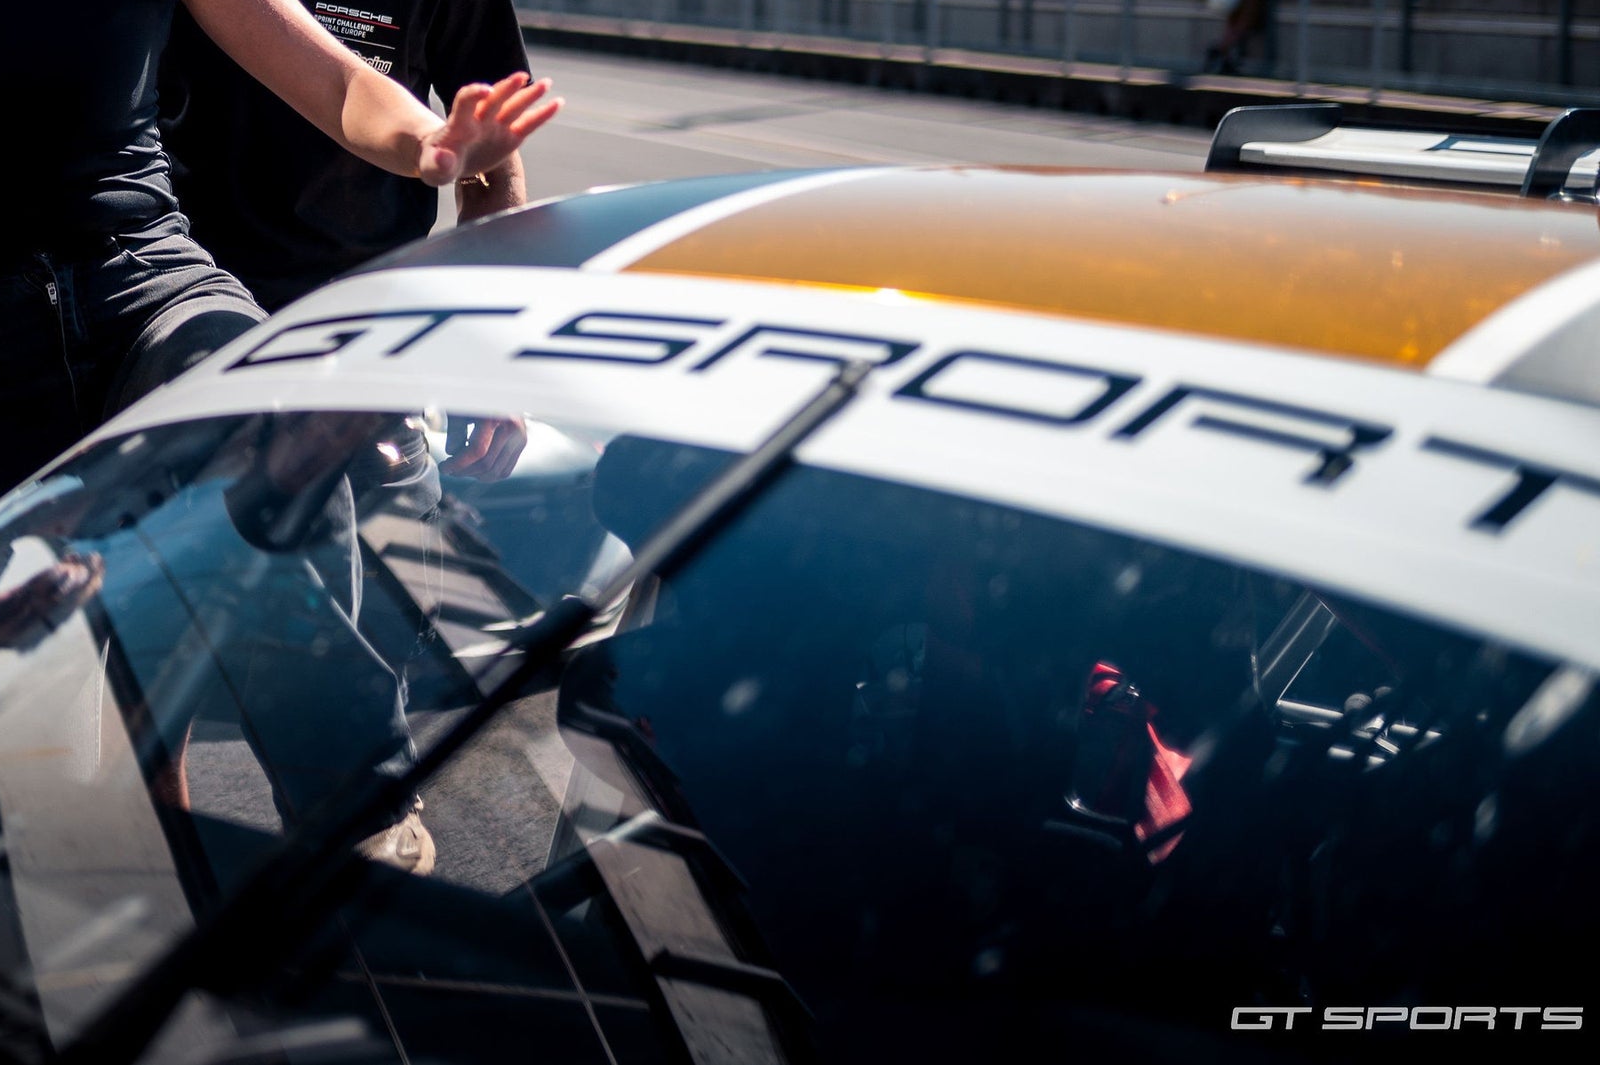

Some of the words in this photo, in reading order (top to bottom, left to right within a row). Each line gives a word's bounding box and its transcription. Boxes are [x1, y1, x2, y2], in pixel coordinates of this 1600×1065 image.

[316, 2, 392, 24] PORSCHE
[337, 18, 375, 33] CHALLENGE
[340, 27, 366, 38] EUROPE
[224, 307, 529, 372] GT
